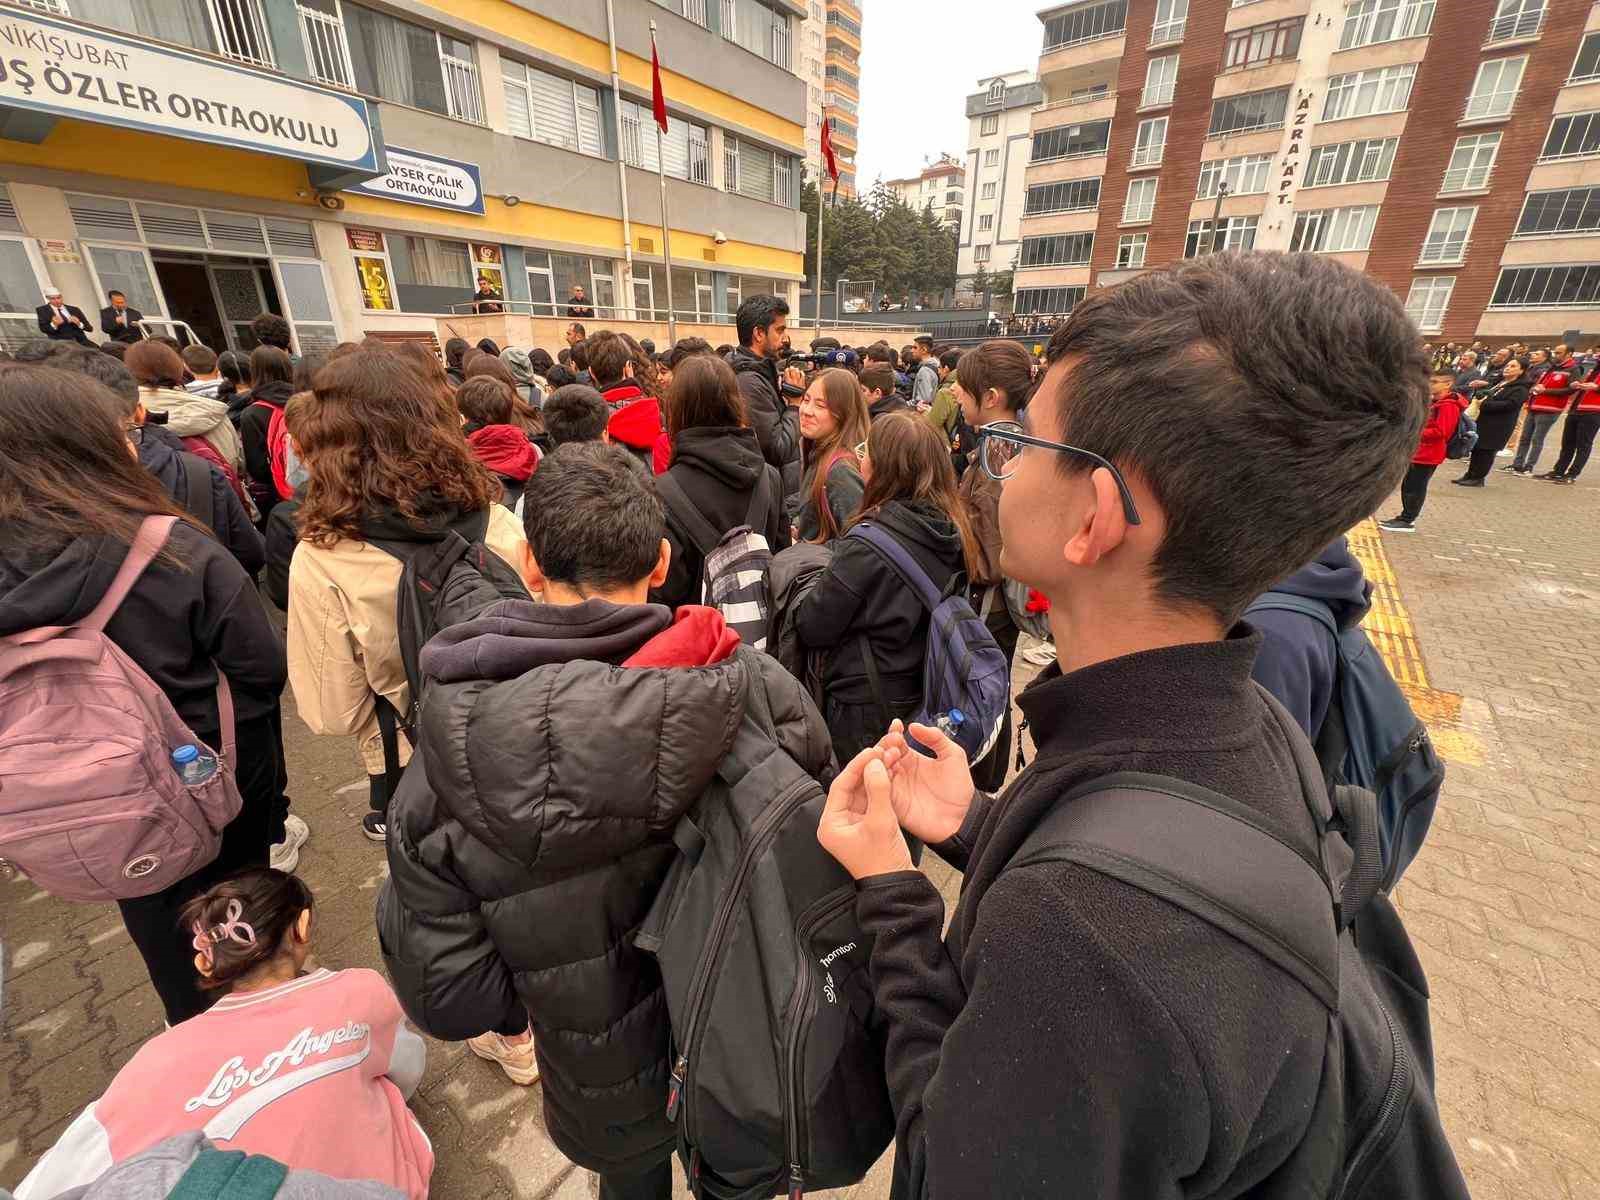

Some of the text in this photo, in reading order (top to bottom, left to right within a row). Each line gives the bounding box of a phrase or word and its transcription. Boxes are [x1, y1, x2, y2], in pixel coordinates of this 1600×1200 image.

[44, 60, 163, 114] ÖZLER
[167, 93, 338, 148] ORTAOKULU
[1288, 98, 1309, 154] AZRA
[386, 178, 457, 200] ORTAOKULU
[427, 173, 464, 189] ÇALIK
[184, 1056, 250, 1113] Los
